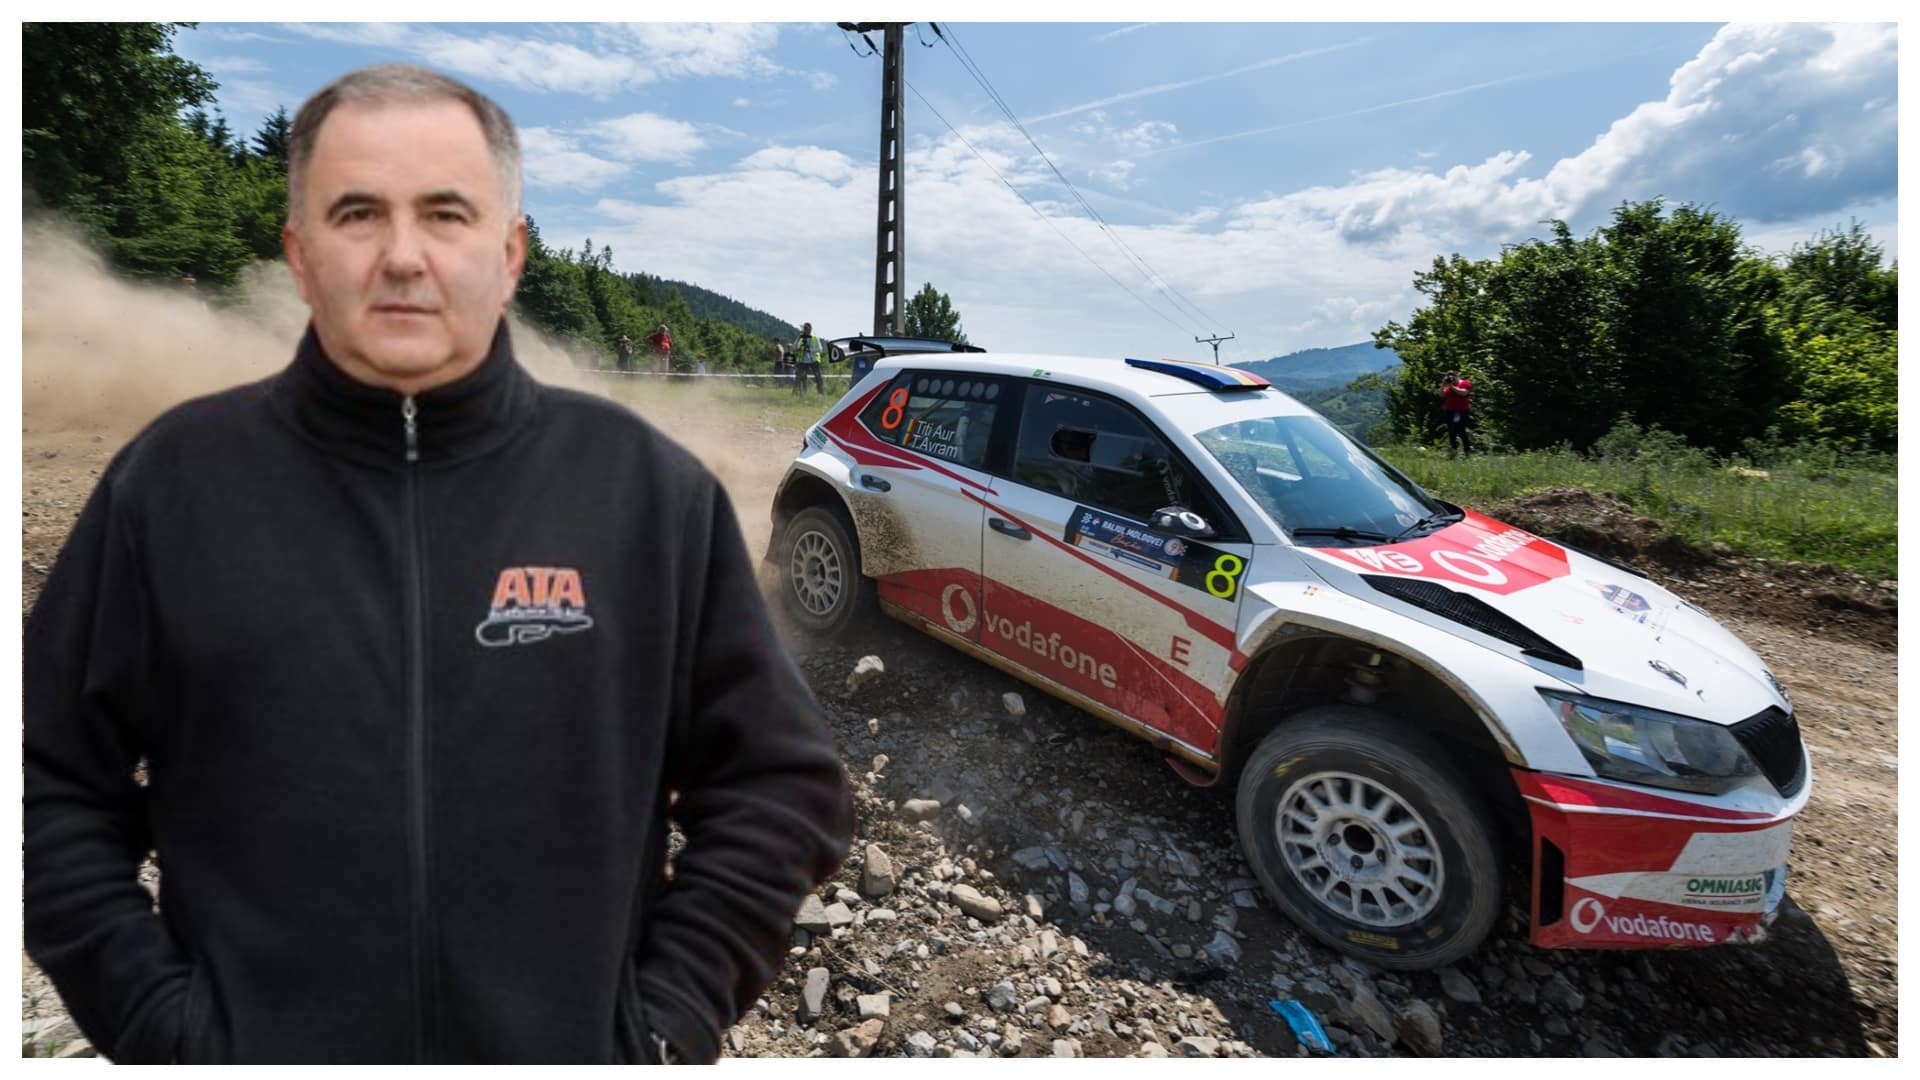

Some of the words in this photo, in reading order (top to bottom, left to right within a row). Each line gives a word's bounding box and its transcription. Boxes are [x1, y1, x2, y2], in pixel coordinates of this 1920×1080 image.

[881, 387, 909, 430] 8
[911, 434, 958, 458] T.Avram
[916, 420, 934, 438] Titi
[934, 423, 955, 441] Aur
[492, 567, 586, 608] ATA
[1205, 554, 1243, 598] 8
[983, 609, 1118, 688] vodafone
[1170, 635, 1191, 666] E
[1603, 912, 1715, 942] vodafone
